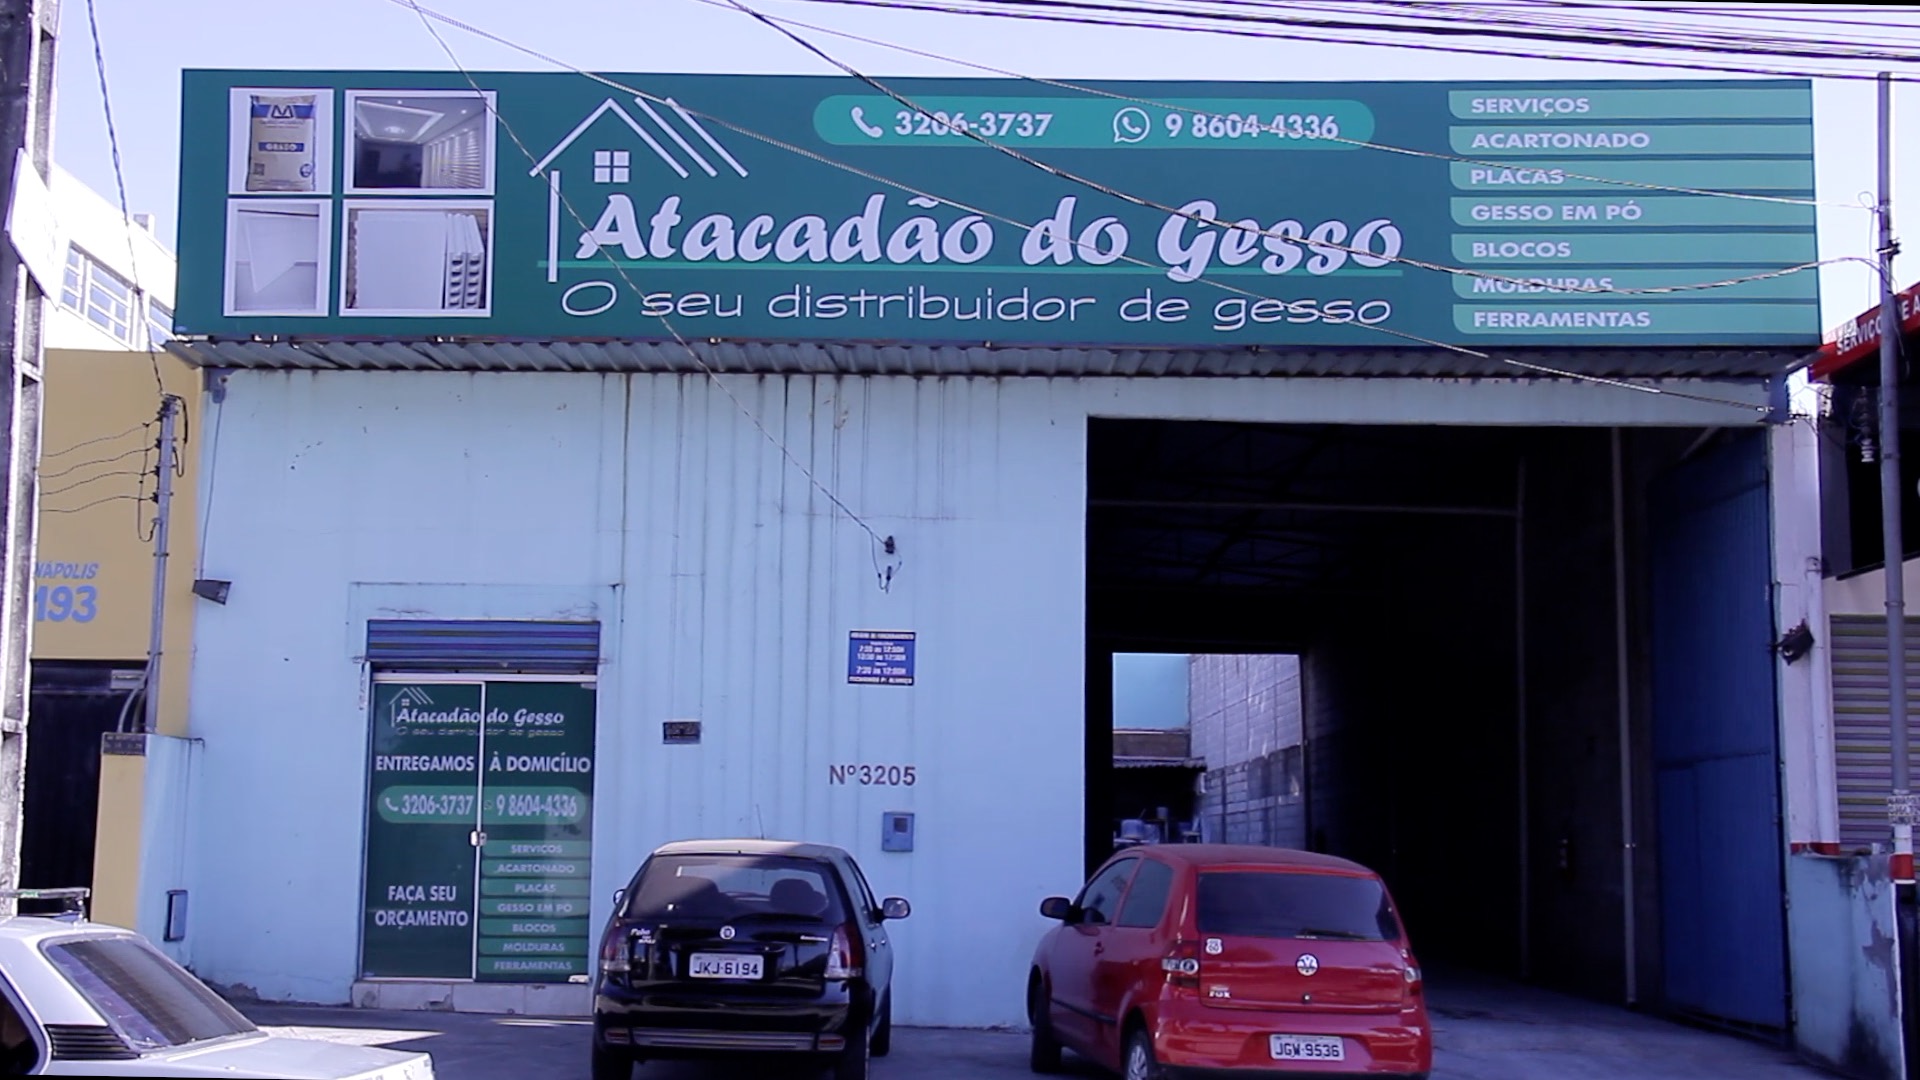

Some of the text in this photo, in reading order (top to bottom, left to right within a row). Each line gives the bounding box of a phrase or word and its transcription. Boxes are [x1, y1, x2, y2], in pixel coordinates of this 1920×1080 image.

[1471, 97, 1590, 117] SERVIÇOS
[894, 110, 1053, 137] 3206-3737
[1165, 115, 1339, 139] 9 8604-4336
[1471, 133, 1650, 148] ACARTONADO
[1471, 169, 1565, 184] PLACAS
[1471, 200, 1641, 221] GESSO EM PÓ
[575, 193, 1402, 283] Atacadão do Gesso
[1473, 242, 1571, 258] BLOCOS
[1473, 277, 1613, 293] MOLDURAS
[562, 281, 1391, 331] O seu distribuidor de gesso
[1474, 312, 1650, 327] FERRAMENTAS
[396, 707, 565, 727] Atacadão do Gesso
[375, 751, 591, 773] ENTREGAMOS À DOMICÍLIO
[401, 794, 577, 817] 3206-3737 9 8604-4336
[497, 863, 576, 873] ACARTONADO
[388, 885, 457, 904] FAÇA SEU
[514, 883, 557, 893] PLACAS
[497, 902, 533, 913] GESSO
[537, 903, 553, 913] EM
[375, 910, 469, 929] ORÇAMENTO
[512, 923, 557, 934] BLOCOS
[502, 942, 566, 953] MOLDURAS
[494, 961, 573, 971] FERRAMENTAS
[693, 961, 760, 977] JKJ-6194
[1275, 1042, 1341, 1058] JGW-9536
